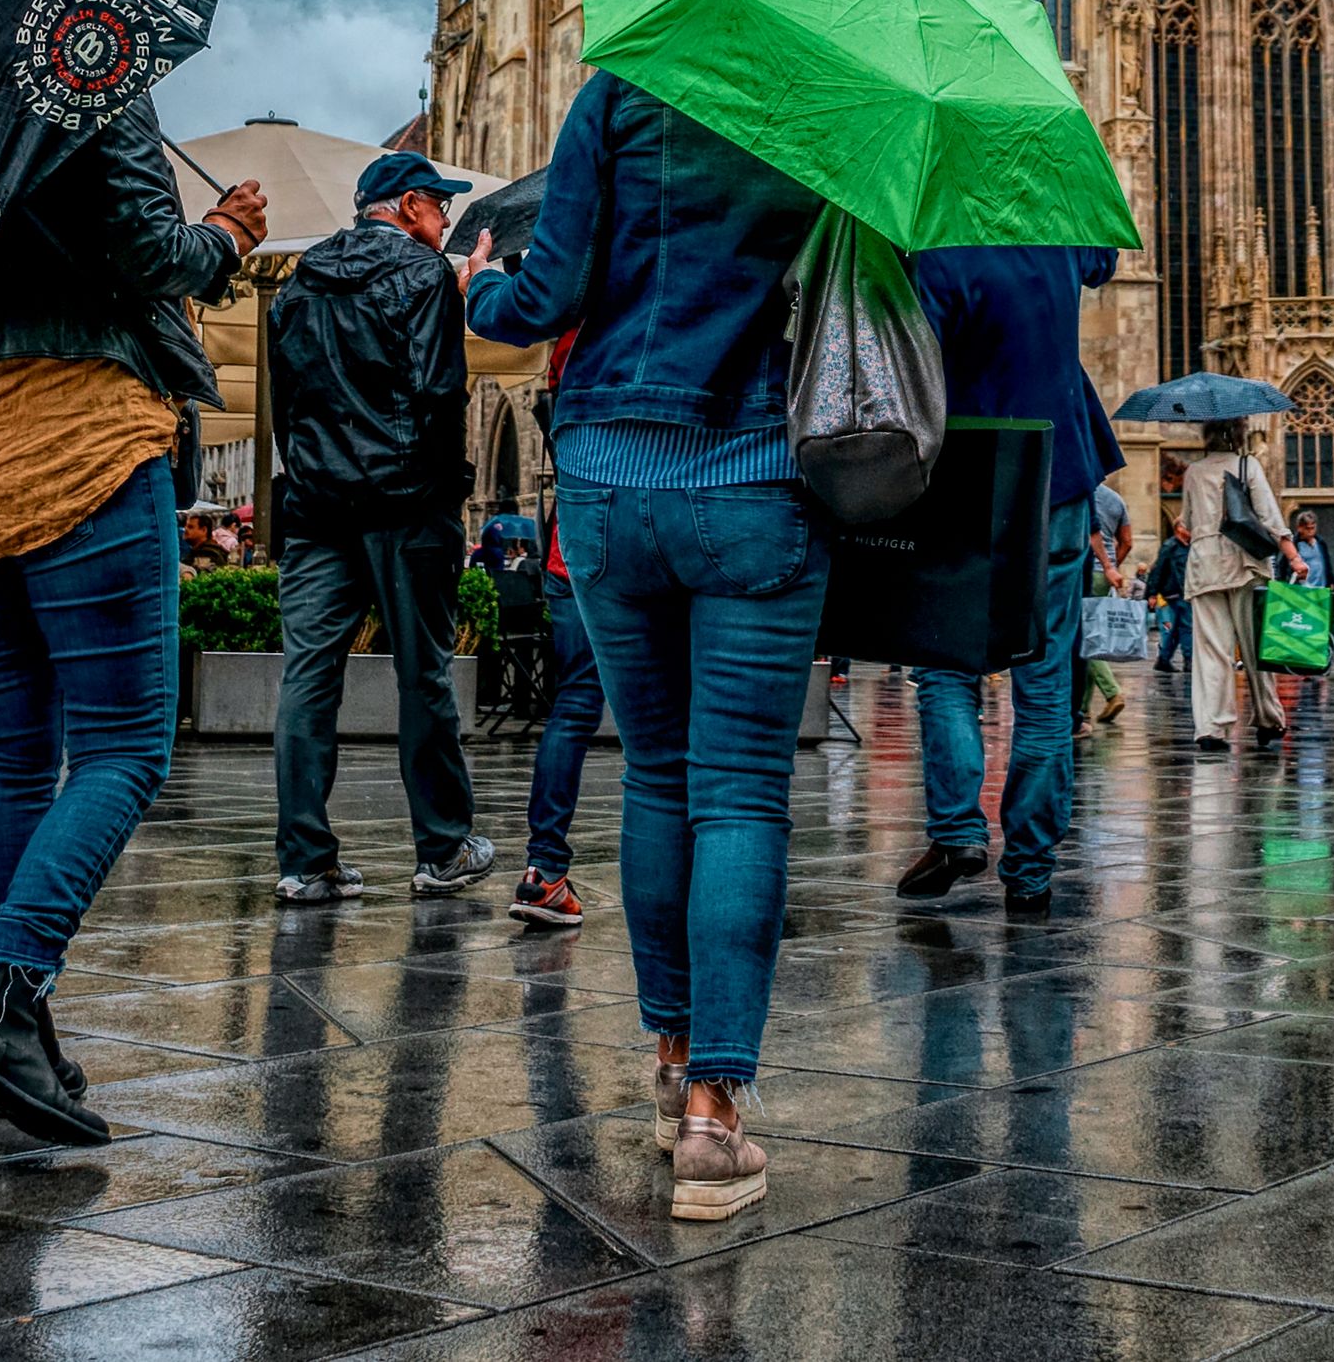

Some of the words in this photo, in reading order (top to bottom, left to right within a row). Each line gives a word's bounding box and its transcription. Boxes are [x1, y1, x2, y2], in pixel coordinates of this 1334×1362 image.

[32, 0, 66, 68] BERLIN
[53, 9, 95, 43] BERLIN
[75, 22, 108, 34] BERLIN
[99, 11, 132, 54] BERLIN
[74, 31, 104, 66] B
[107, 33, 119, 68] BERLIN
[115, 31, 150, 98] BERLIN
[51, 48, 83, 89] BERLIN
[74, 66, 107, 78] BERLIN
[87, 60, 130, 91] BERLIN
[13, 59, 81, 130] BERLIN
[41, 75, 107, 108] BERLIN
[855, 535, 915, 551] HILFIGER
